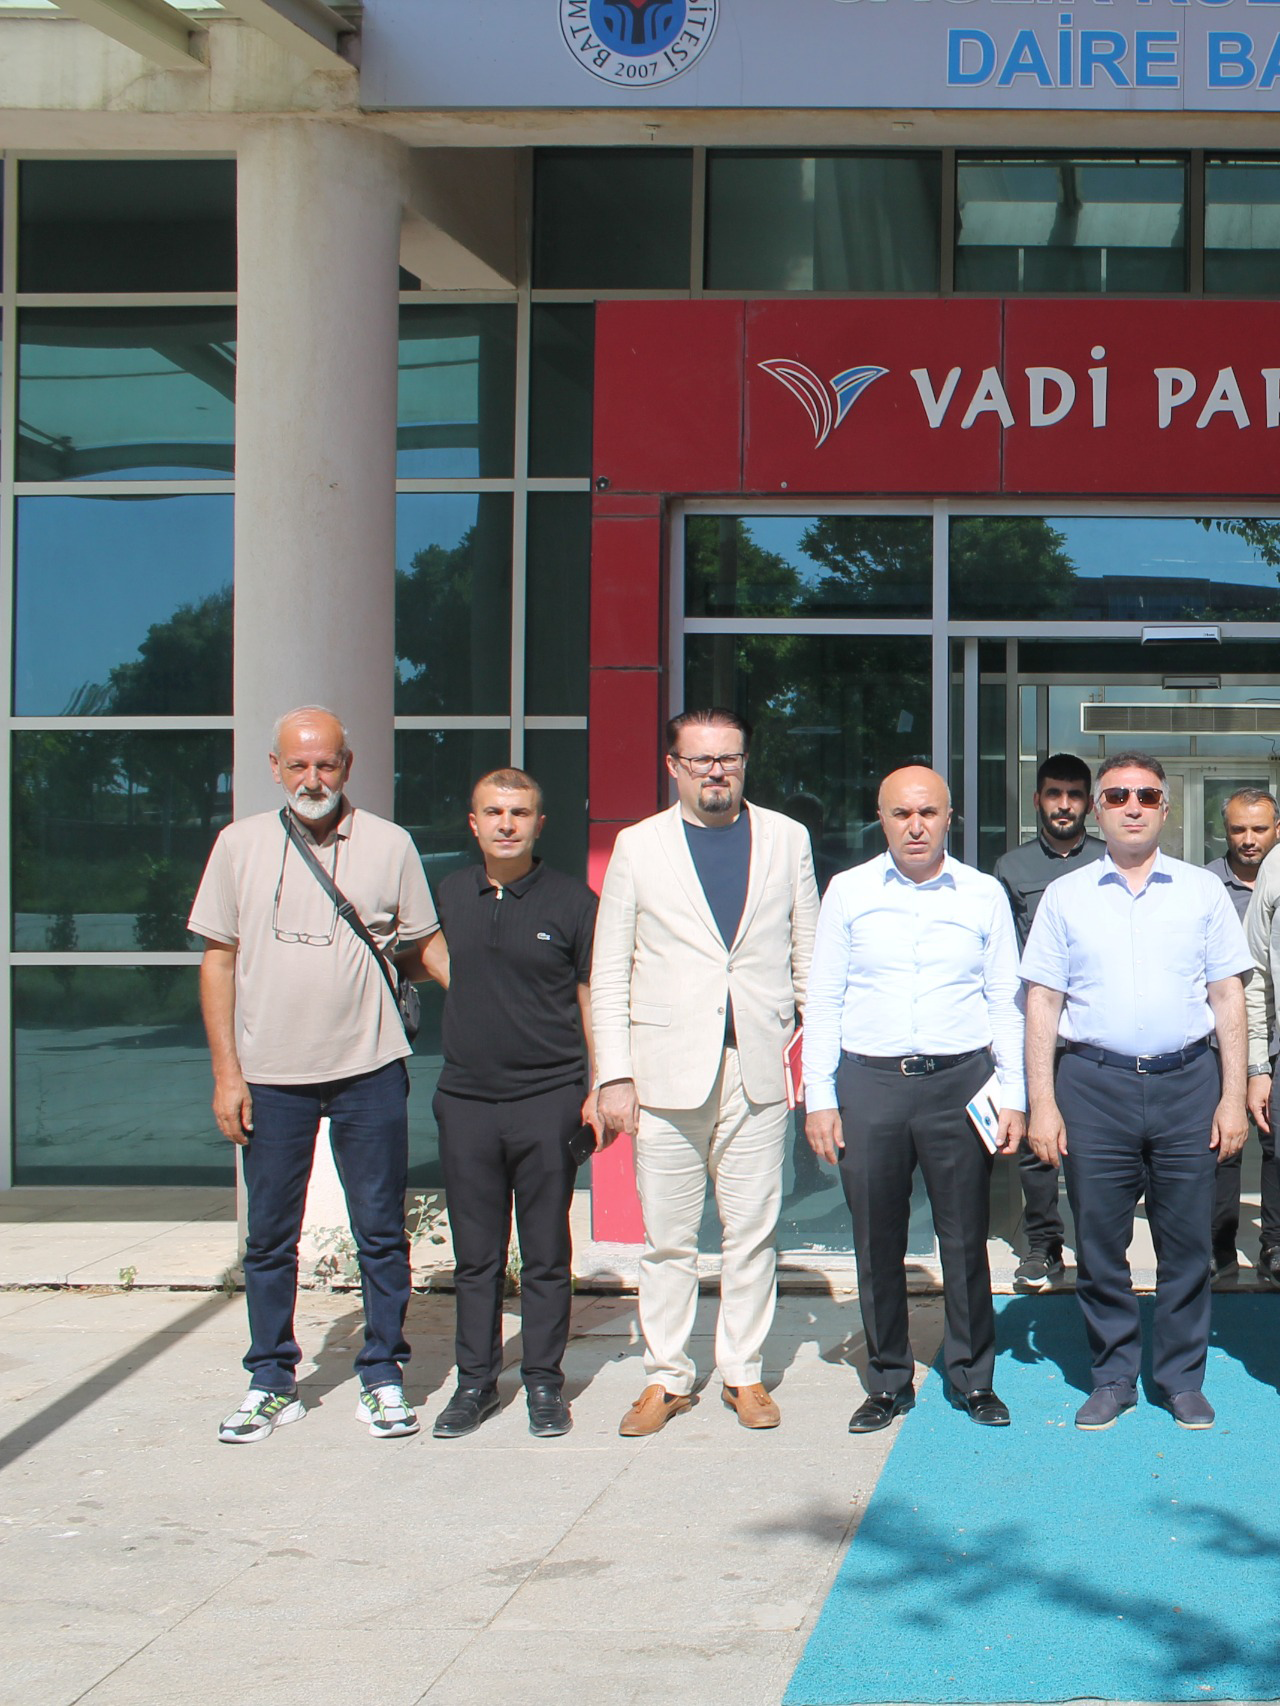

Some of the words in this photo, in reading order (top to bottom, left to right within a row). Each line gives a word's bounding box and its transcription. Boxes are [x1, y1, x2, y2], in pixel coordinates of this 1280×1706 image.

[567, 0, 612, 68] BATM
[614, 62, 658, 78] 2007
[946, 12, 1181, 89] DAİRE
[910, 345, 1108, 429] VADİ
